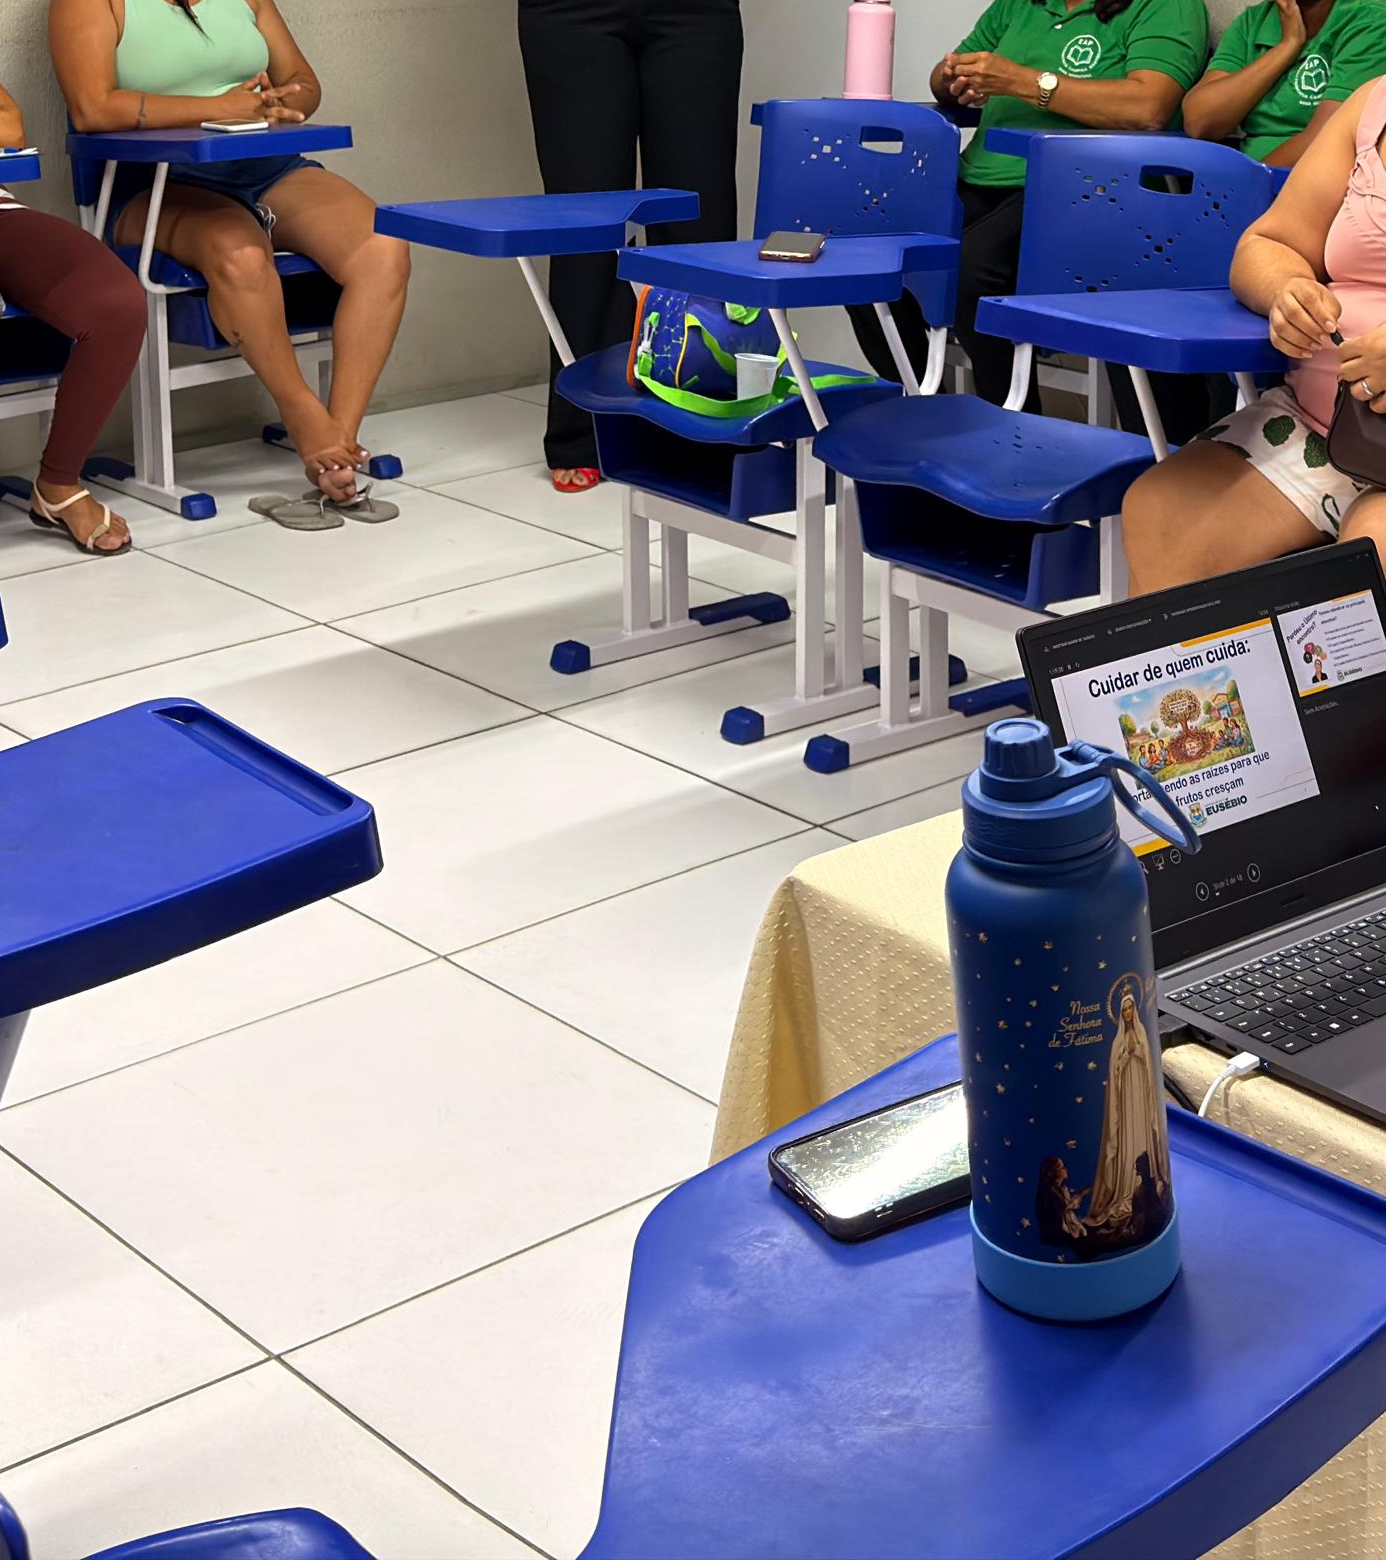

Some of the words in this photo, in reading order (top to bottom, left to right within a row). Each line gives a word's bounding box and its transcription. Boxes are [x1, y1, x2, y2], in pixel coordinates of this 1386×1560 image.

[1088, 668, 1139, 698] Cuidar
[1143, 663, 1163, 683] de
[1165, 652, 1205, 679] quem
[1205, 638, 1251, 664] cuida:
[1188, 774, 1201, 786] as
[1201, 763, 1230, 783] raízes
[1231, 757, 1252, 774] para
[1253, 750, 1271, 766] que
[1175, 787, 1204, 807] frutos
[1205, 776, 1245, 799] cresçam
[1205, 794, 1248, 816] EUSÉBIO
[1070, 1000, 1100, 1014] Nossa
[1058, 1015, 1101, 1032] Senhora
[1048, 1033, 1061, 1048] de
